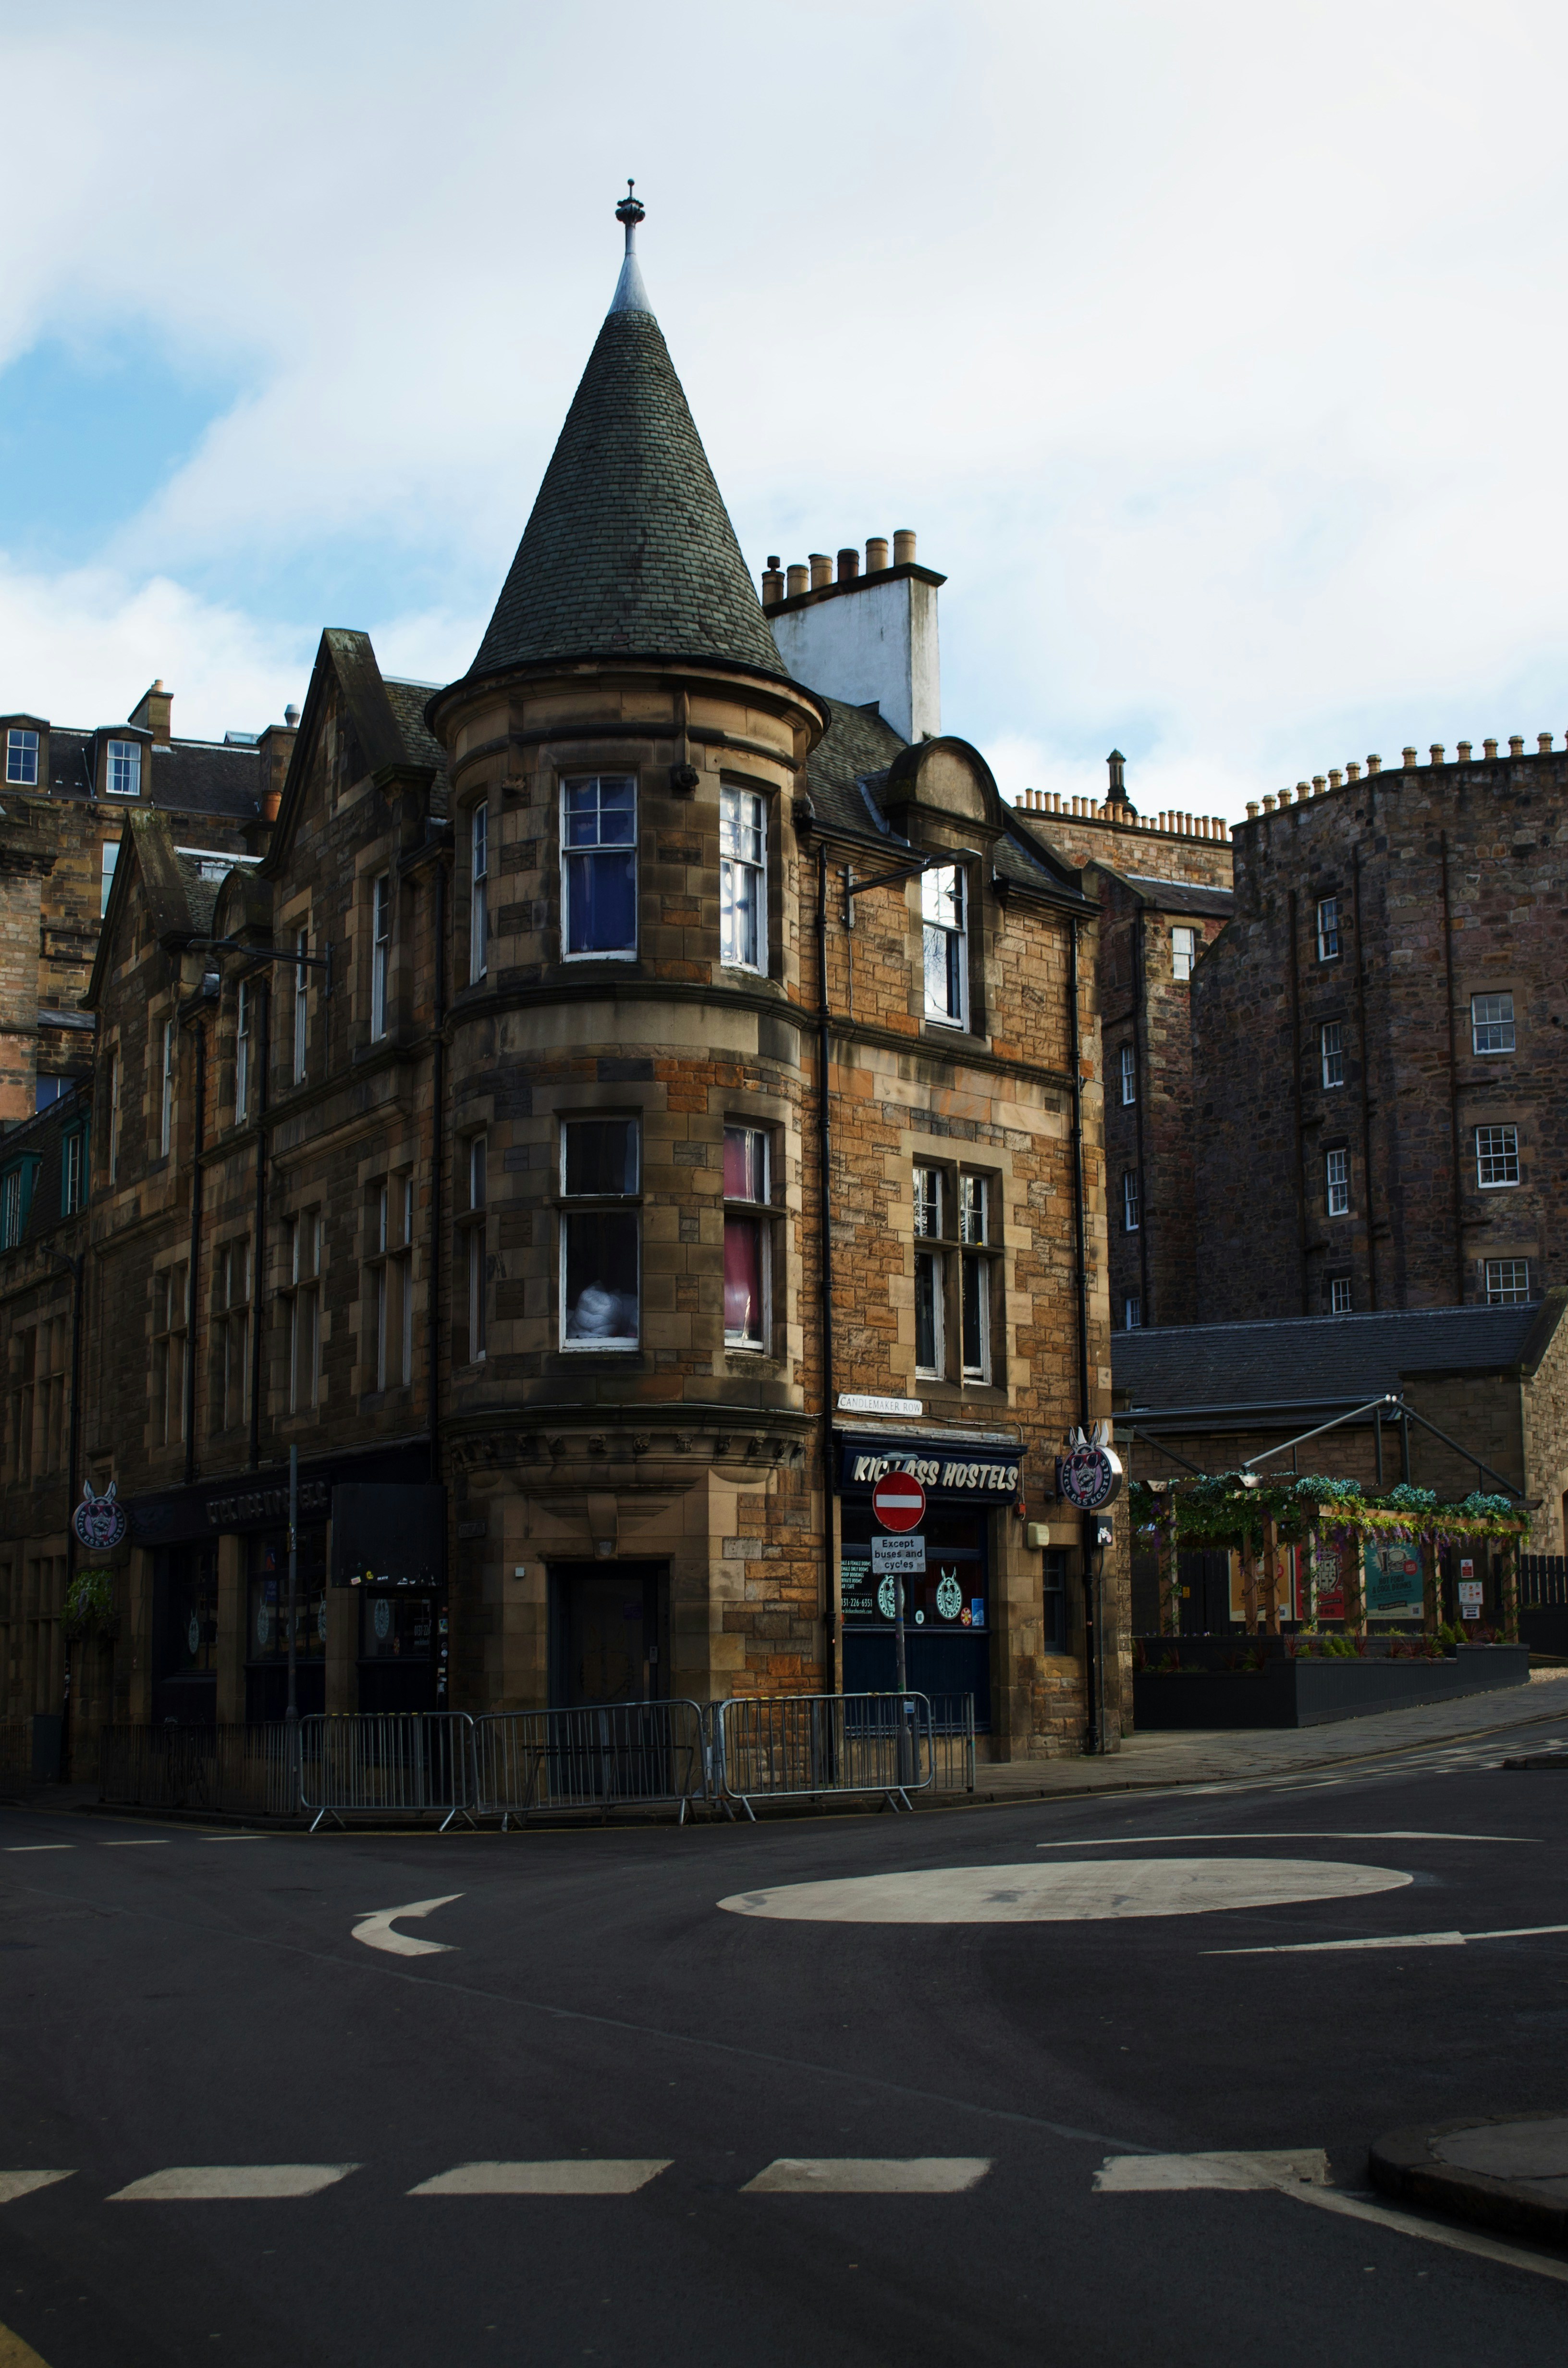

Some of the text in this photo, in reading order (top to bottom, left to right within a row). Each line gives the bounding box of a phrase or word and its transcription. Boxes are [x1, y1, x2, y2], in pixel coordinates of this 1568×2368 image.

[840, 1396, 920, 1412] CANDLEMAKER ROW
[853, 1455, 1018, 1492] KIC ASS HOSTELS
[1064, 1459, 1110, 1505] KICK ASS HOSTELS
[78, 1511, 86, 1534] KICK
[84, 1535, 100, 1546] ASS
[103, 1511, 124, 1546] HOSTELS
[882, 1539, 914, 1548] Except
[875, 1549, 922, 1558] buses and
[1378, 1575, 1405, 1585] HOT FOOD
[1377, 1584, 1390, 1593] COOL
[1392, 1581, 1412, 1591] DRINKS
[842, 1597, 873, 1607] 131-226-6351
